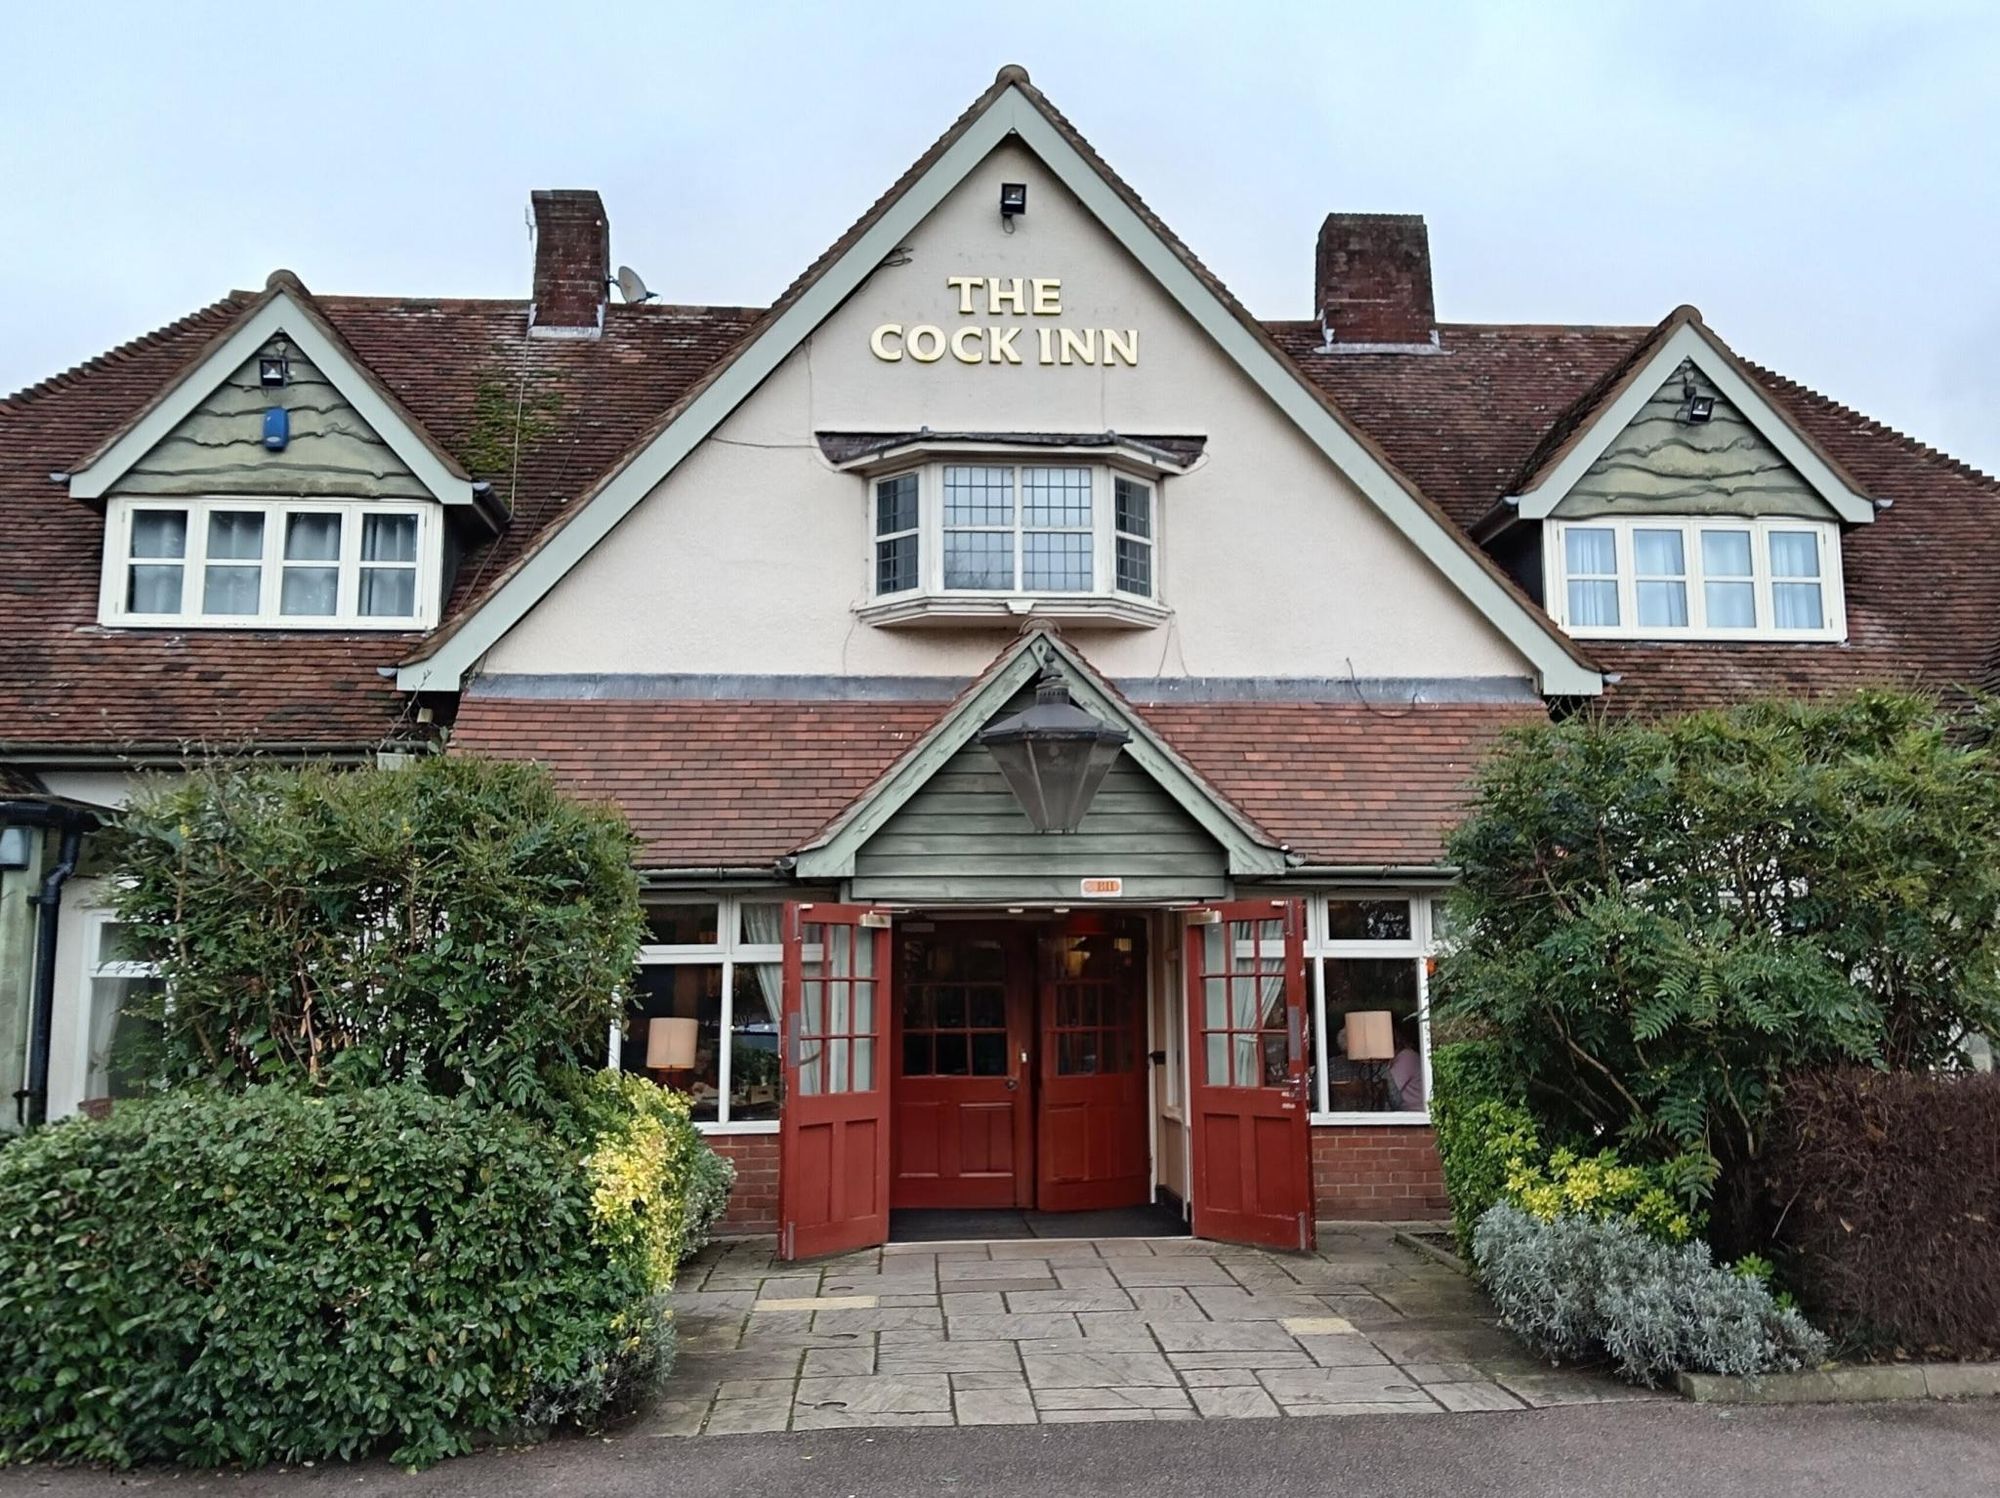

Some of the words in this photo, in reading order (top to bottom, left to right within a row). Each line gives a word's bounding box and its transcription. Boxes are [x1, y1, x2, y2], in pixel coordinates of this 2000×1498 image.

[948, 276, 1062, 315] THE
[870, 324, 1023, 365] COCK
[1036, 328, 1139, 366] INN
